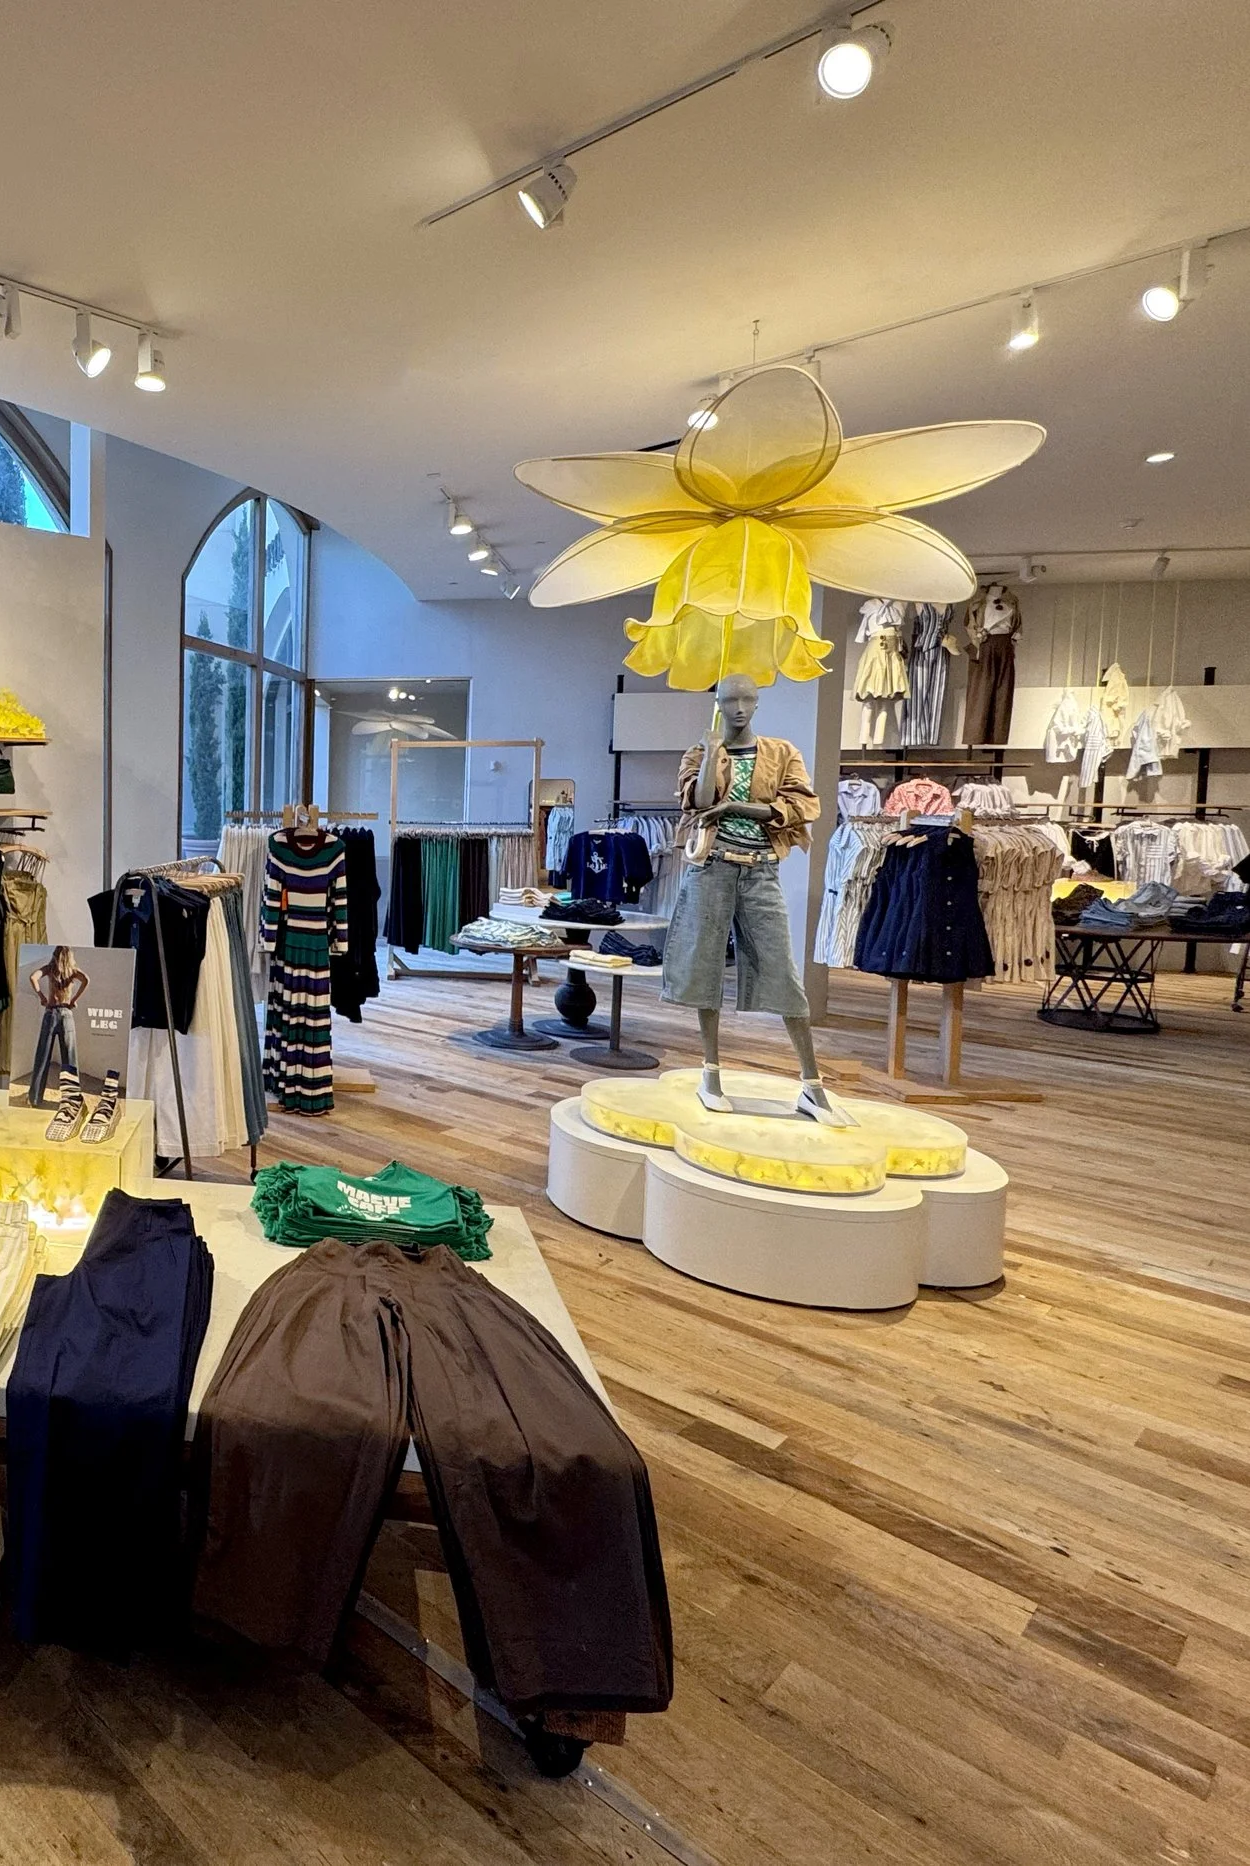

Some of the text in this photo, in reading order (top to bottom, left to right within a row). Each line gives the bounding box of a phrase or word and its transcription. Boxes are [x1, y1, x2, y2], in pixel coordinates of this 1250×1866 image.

[87, 1008, 123, 1018] WIDE
[91, 1020, 117, 1030] LEG
[336, 1180, 412, 1208] MAEVE
